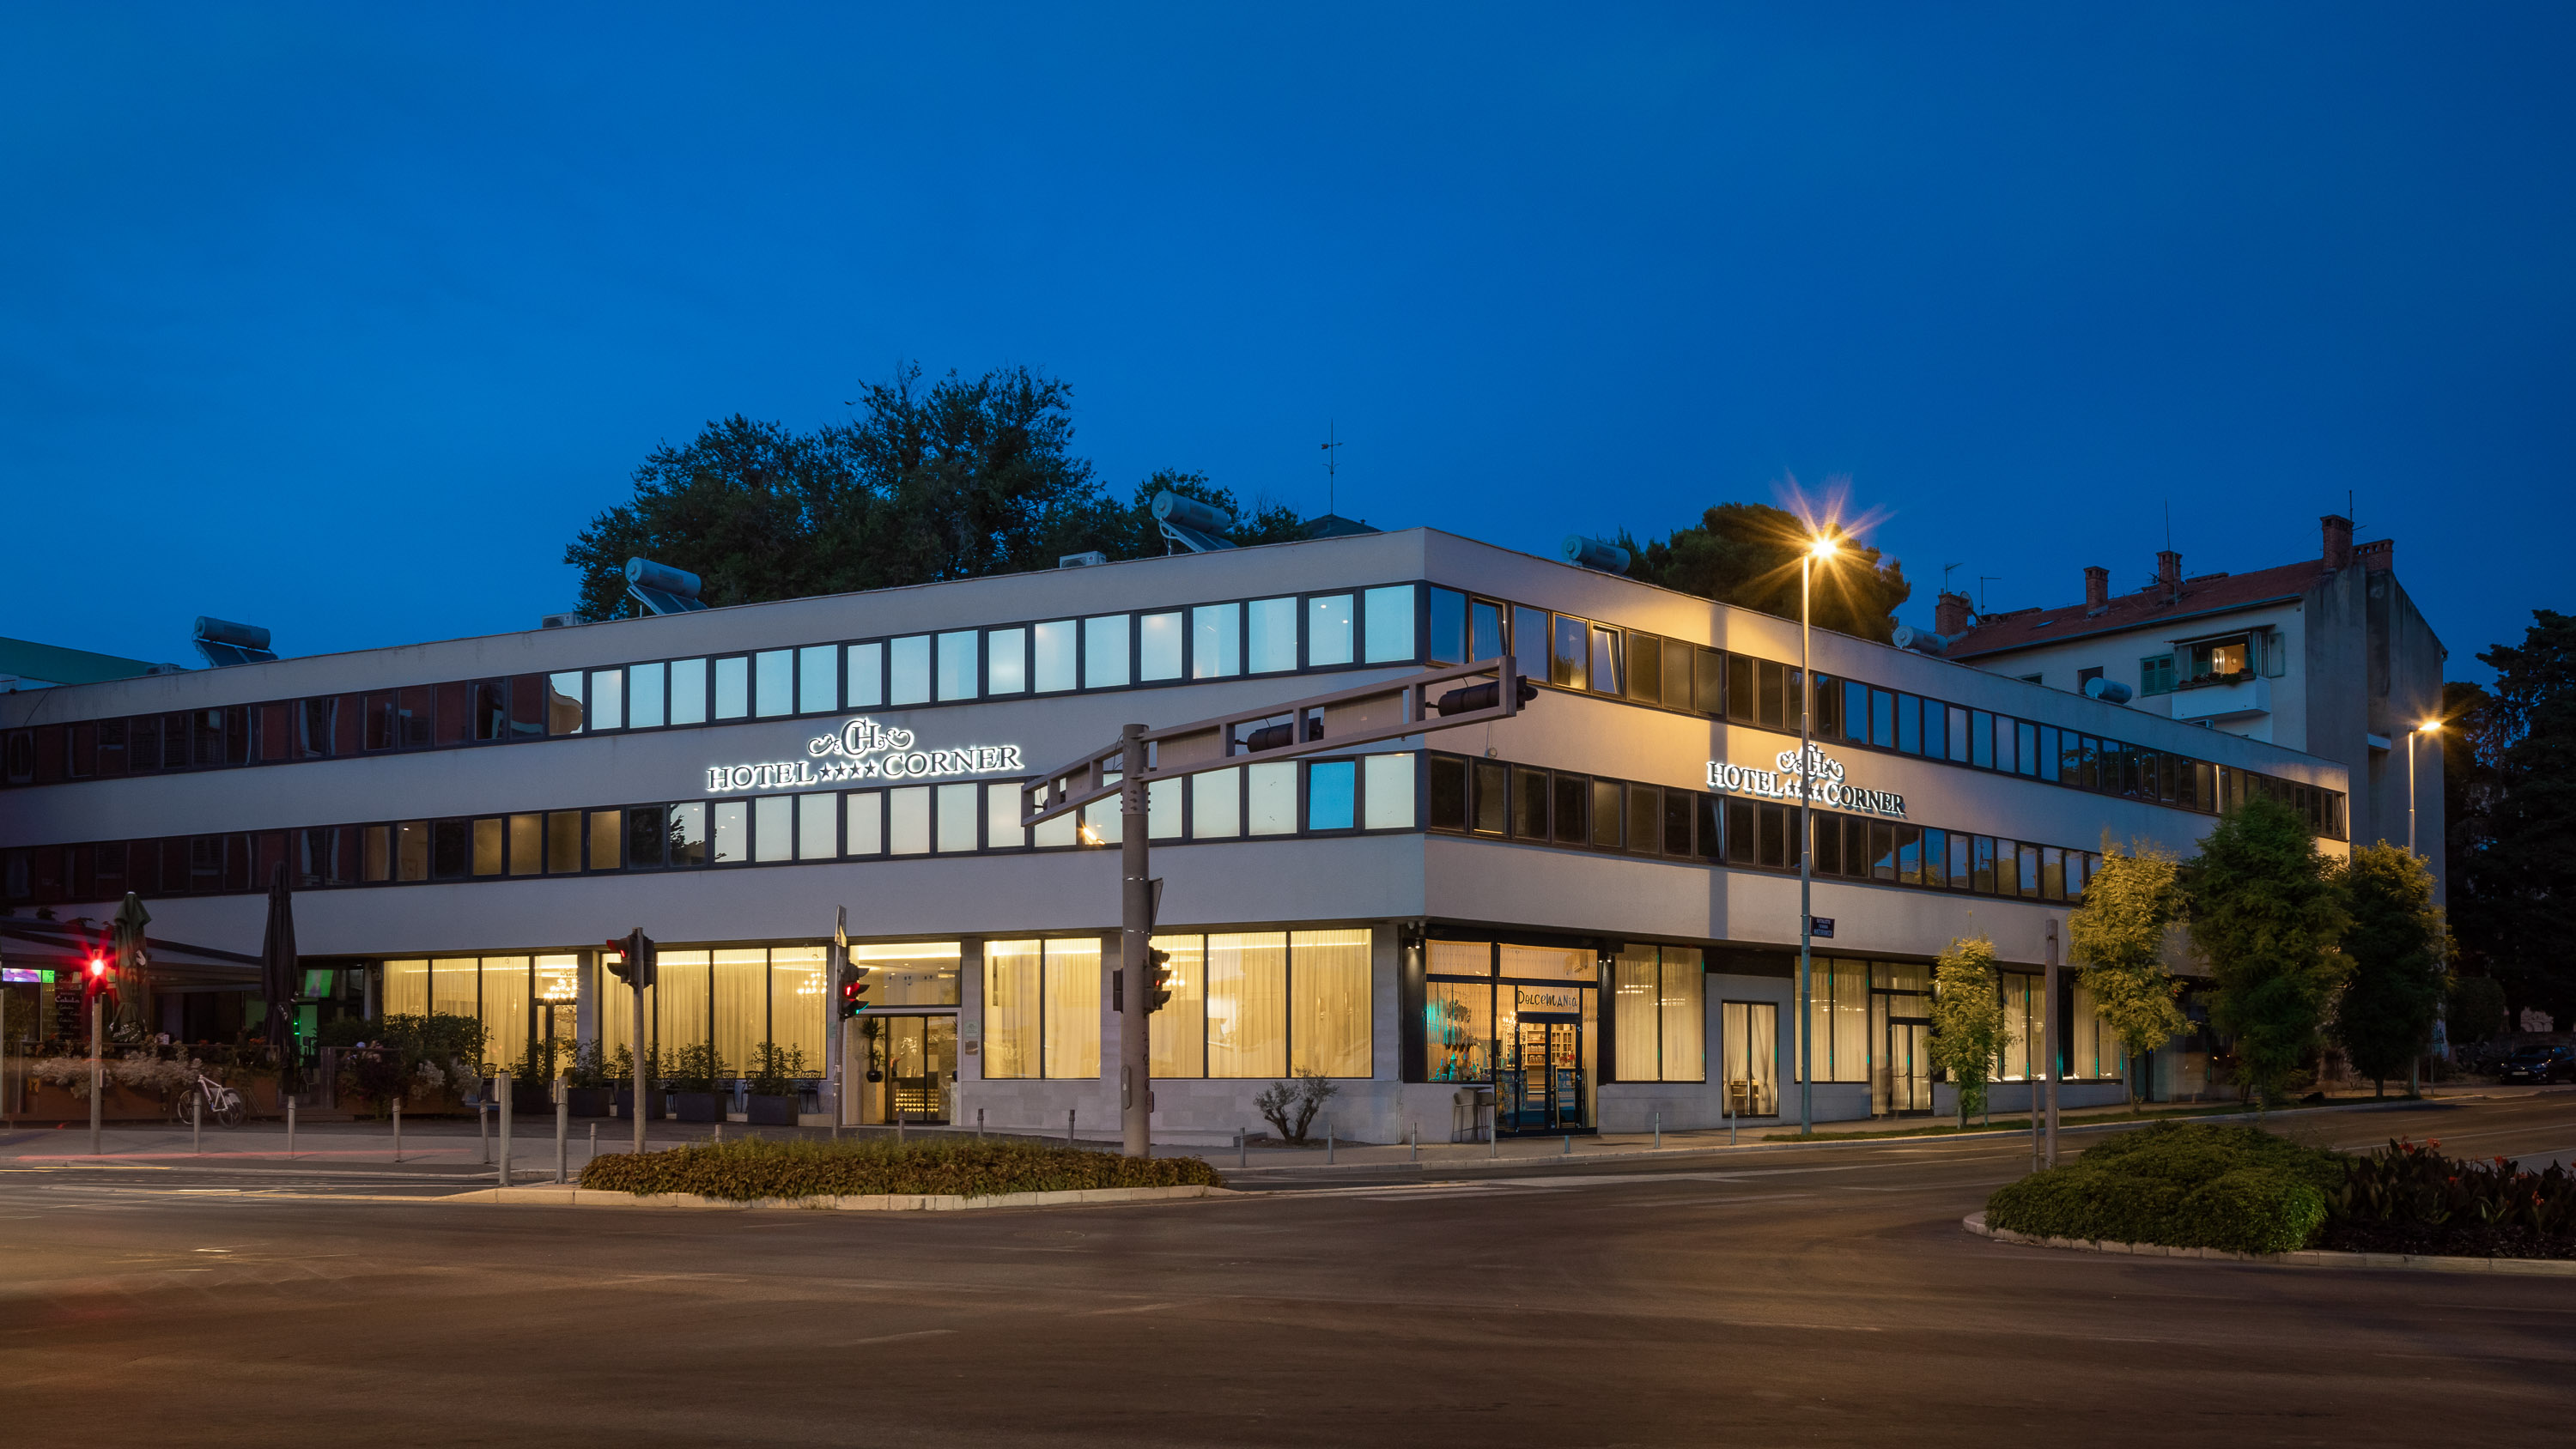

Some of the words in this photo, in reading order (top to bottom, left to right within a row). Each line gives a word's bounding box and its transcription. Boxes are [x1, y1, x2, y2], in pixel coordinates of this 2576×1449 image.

[708, 762, 816, 791] HOTEL
[883, 746, 1023, 777] CORNER
[1707, 761, 1783, 795] HOTEL
[1825, 782, 1906, 814] CORNER
